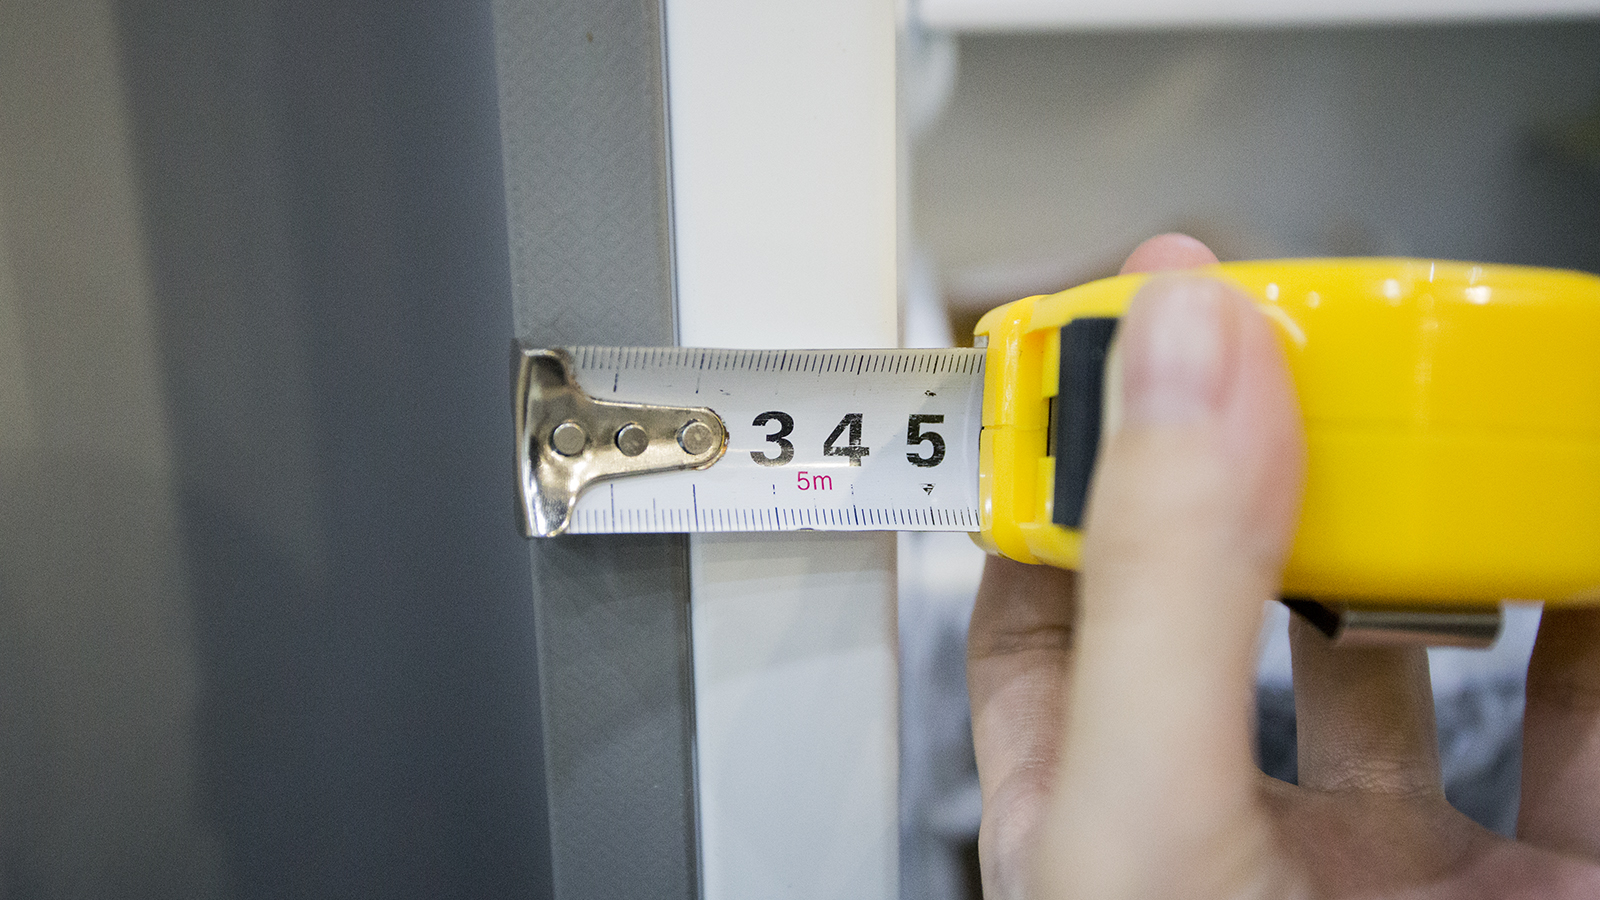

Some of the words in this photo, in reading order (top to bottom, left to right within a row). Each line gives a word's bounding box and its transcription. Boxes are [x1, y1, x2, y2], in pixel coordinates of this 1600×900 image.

[750, 411, 795, 467] 3
[823, 413, 870, 467] 4
[906, 414, 946, 468] 5
[797, 471, 833, 491] 5m
